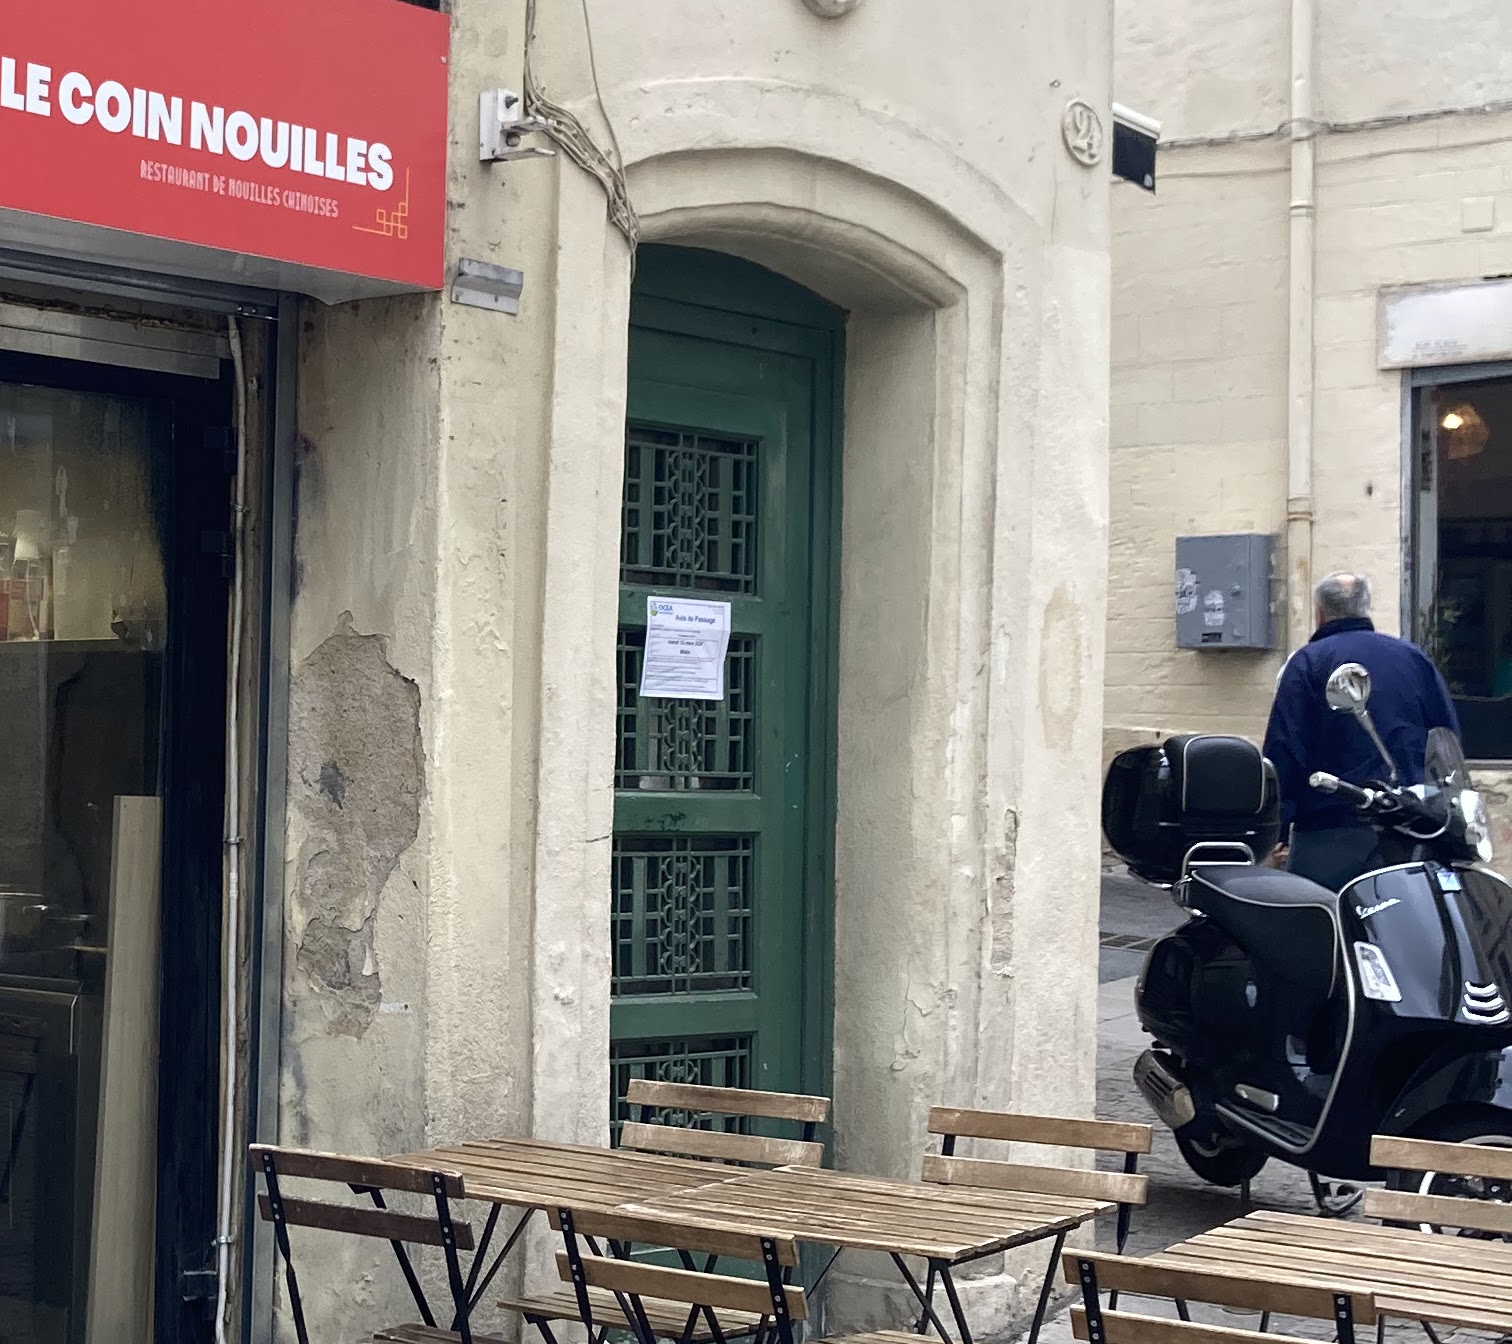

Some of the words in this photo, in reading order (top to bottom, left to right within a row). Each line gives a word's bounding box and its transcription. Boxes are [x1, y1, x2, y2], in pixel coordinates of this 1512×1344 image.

[0, 56, 52, 117] LE
[59, 71, 183, 145] COIN
[190, 100, 394, 191] NOUILLES
[140, 159, 210, 192] RESTAURANT
[212, 175, 226, 196] DE
[228, 178, 281, 207] NOUILLES
[282, 189, 339, 218] CHINOISES
